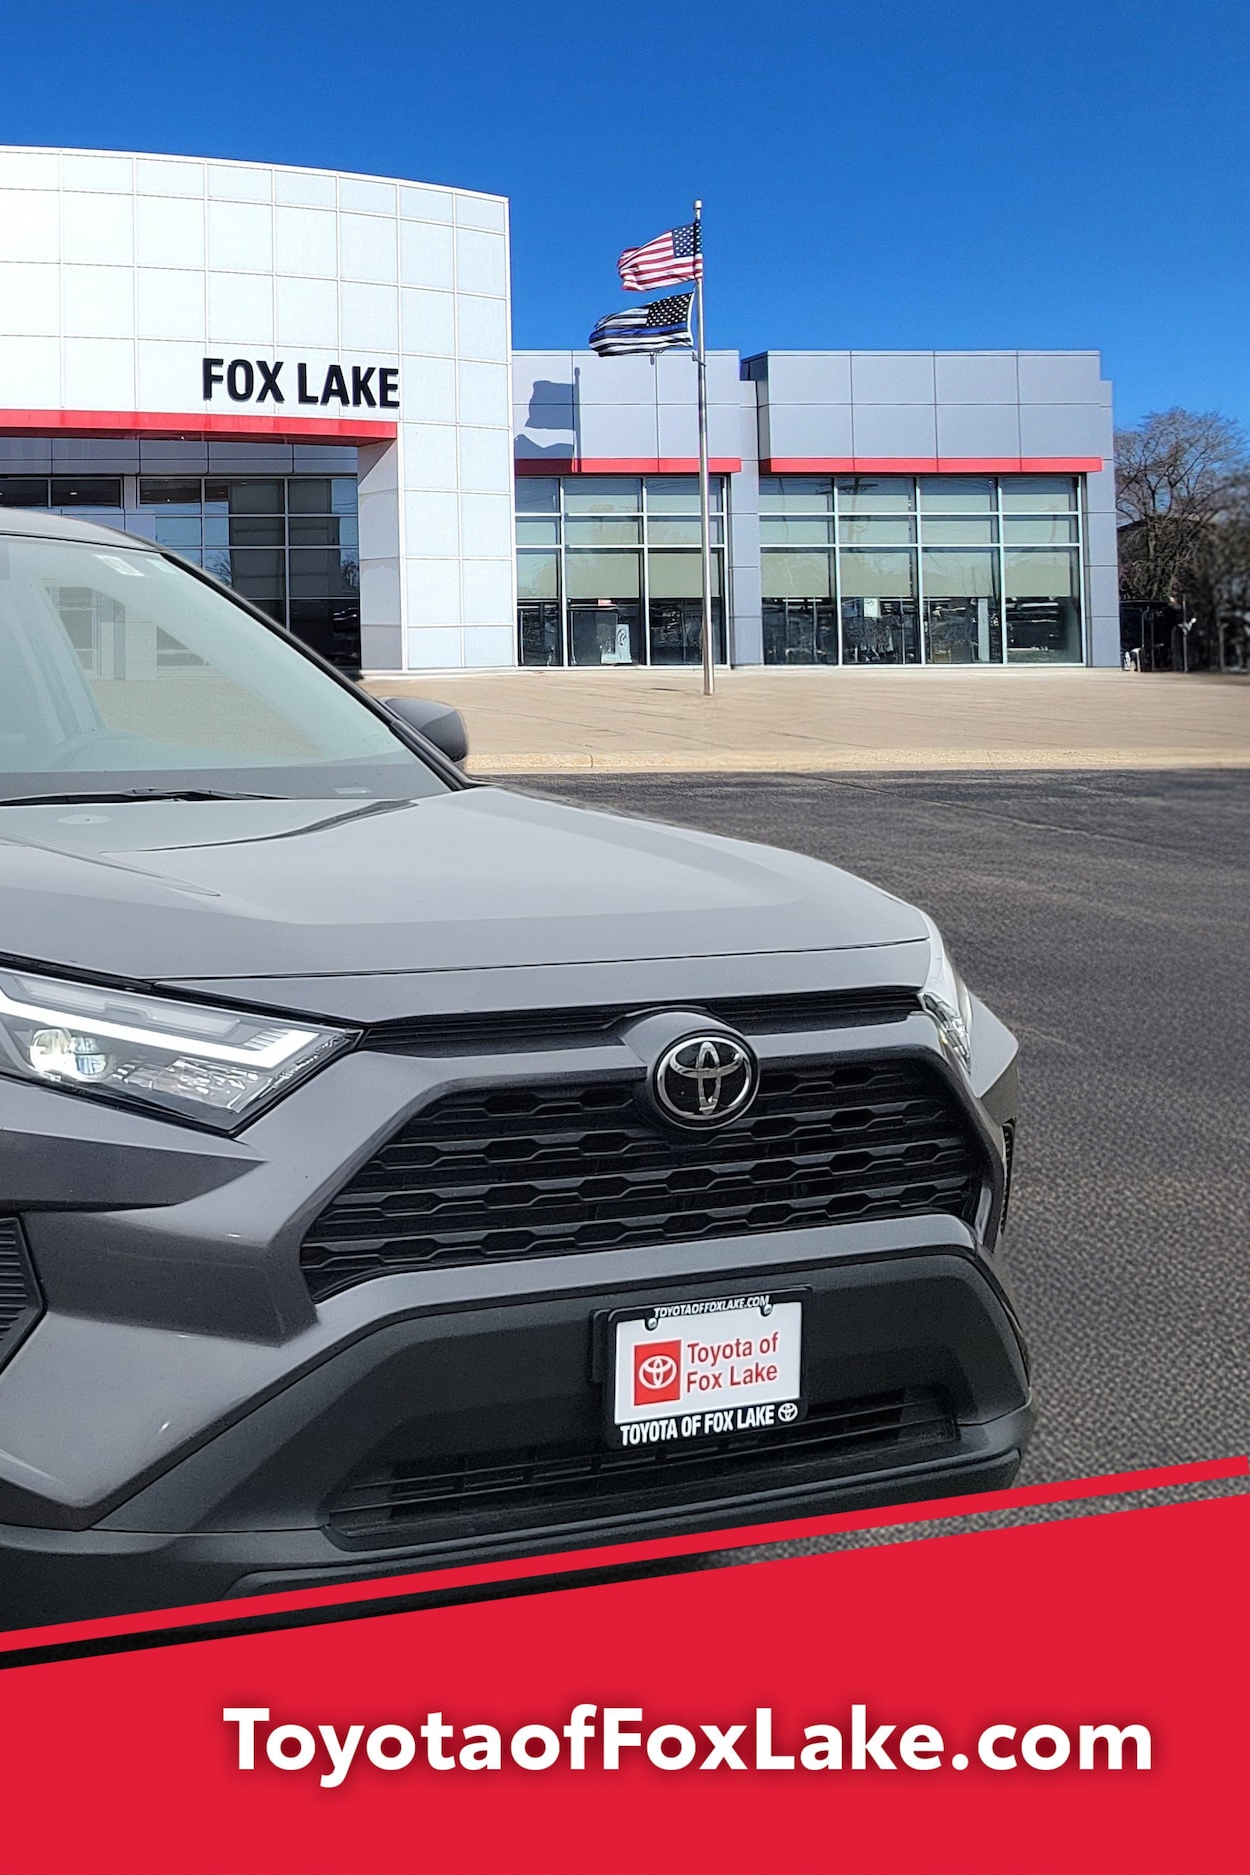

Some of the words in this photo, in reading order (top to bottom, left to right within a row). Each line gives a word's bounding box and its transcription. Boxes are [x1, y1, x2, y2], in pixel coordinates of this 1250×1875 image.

[202, 357, 285, 403] FOX
[297, 362, 400, 408] LAKE
[654, 1295, 770, 1319] TOYOTAOFFOXLAKE.COM
[687, 1338, 753, 1367] Toyota
[759, 1331, 779, 1354] of
[686, 1370, 723, 1393] Fox
[730, 1362, 778, 1386] Lake
[620, 1418, 678, 1446] TOYOTA
[681, 1414, 702, 1437] OF
[704, 1409, 734, 1434] FOX
[737, 1404, 775, 1429] LAKE
